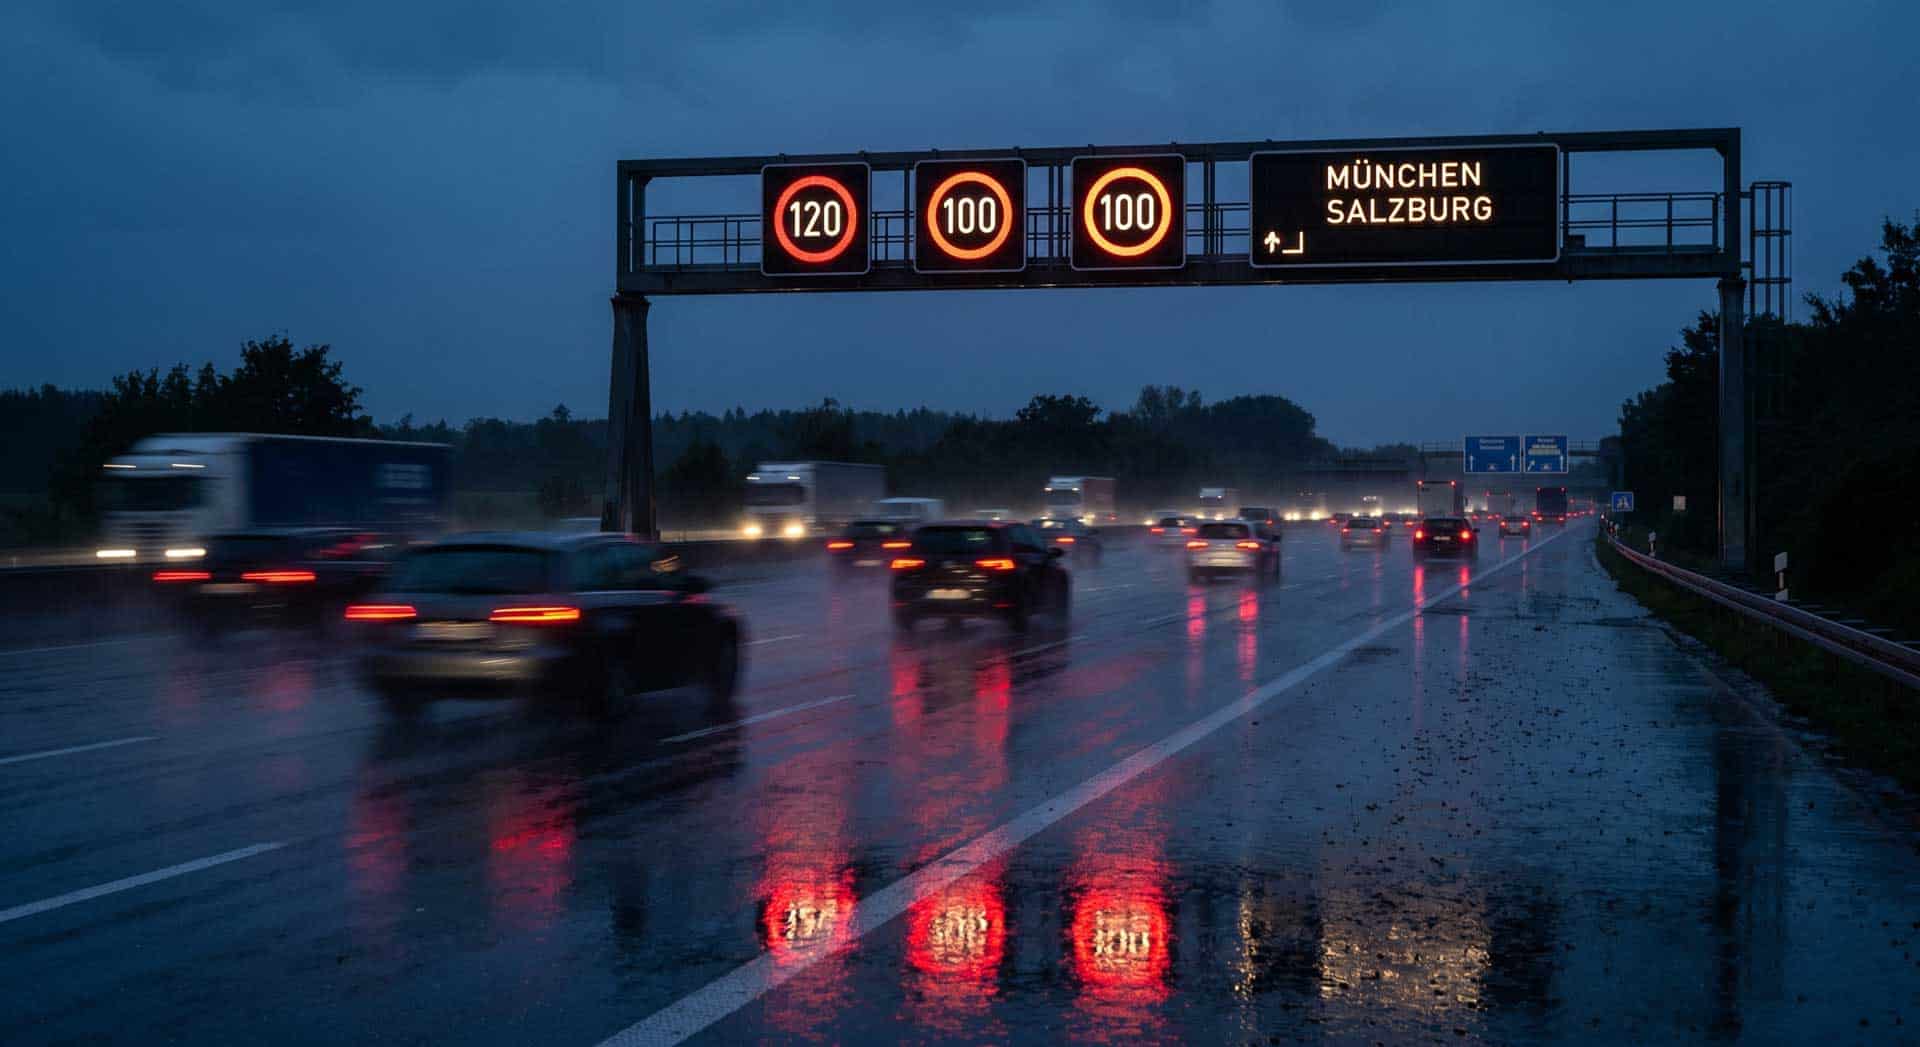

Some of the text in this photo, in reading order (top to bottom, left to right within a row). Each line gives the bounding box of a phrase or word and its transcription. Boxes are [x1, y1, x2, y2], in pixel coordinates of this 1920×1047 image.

[1327, 160, 1481, 190] MÜNCHEN
[789, 200, 841, 237] 120
[943, 196, 996, 234] 100
[1100, 193, 1155, 231] 100
[1327, 196, 1492, 224] SALZBURG
